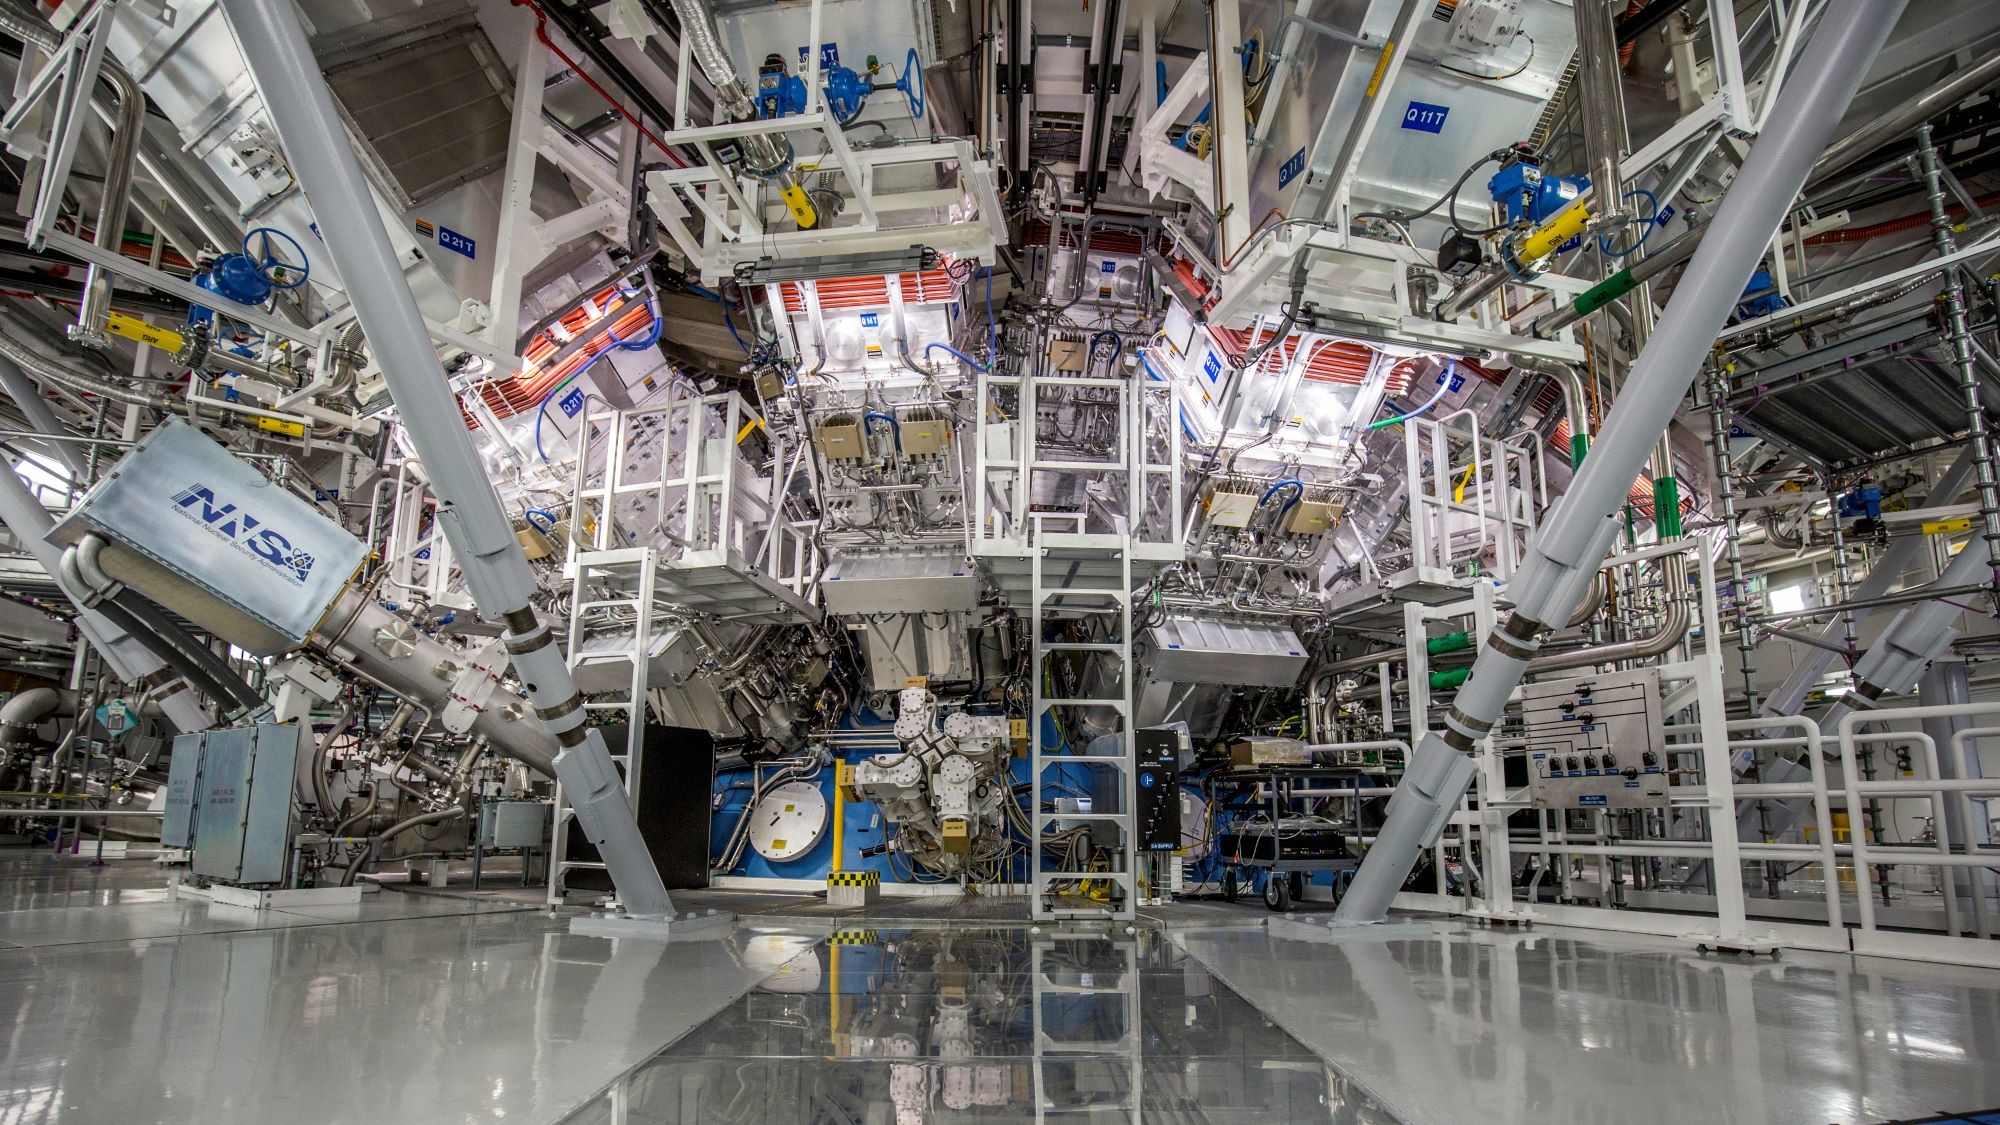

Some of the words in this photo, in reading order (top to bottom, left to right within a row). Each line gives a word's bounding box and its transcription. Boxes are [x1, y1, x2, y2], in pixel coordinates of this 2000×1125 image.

[142, 333, 159, 344] ARG
[172, 504, 203, 528] National
[203, 523, 231, 543] Nuclear
[230, 541, 257, 561] Security
[257, 558, 303, 589] Administration
